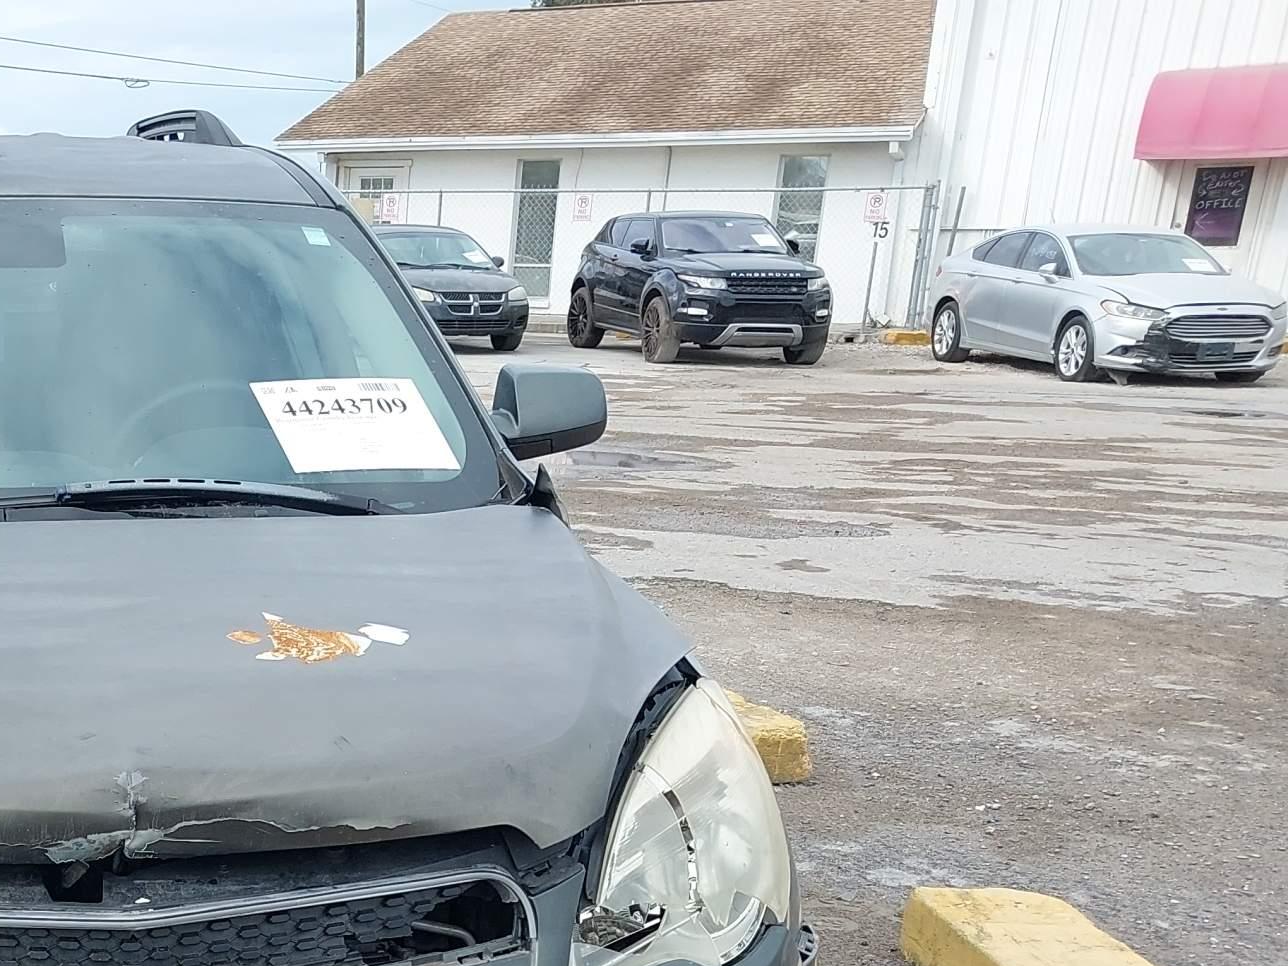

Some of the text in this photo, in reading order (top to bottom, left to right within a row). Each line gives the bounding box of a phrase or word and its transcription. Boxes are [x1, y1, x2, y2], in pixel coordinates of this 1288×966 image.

[1195, 198, 1243, 210] OFFICE
[872, 221, 890, 238] 15
[282, 398, 407, 416] 44243709
